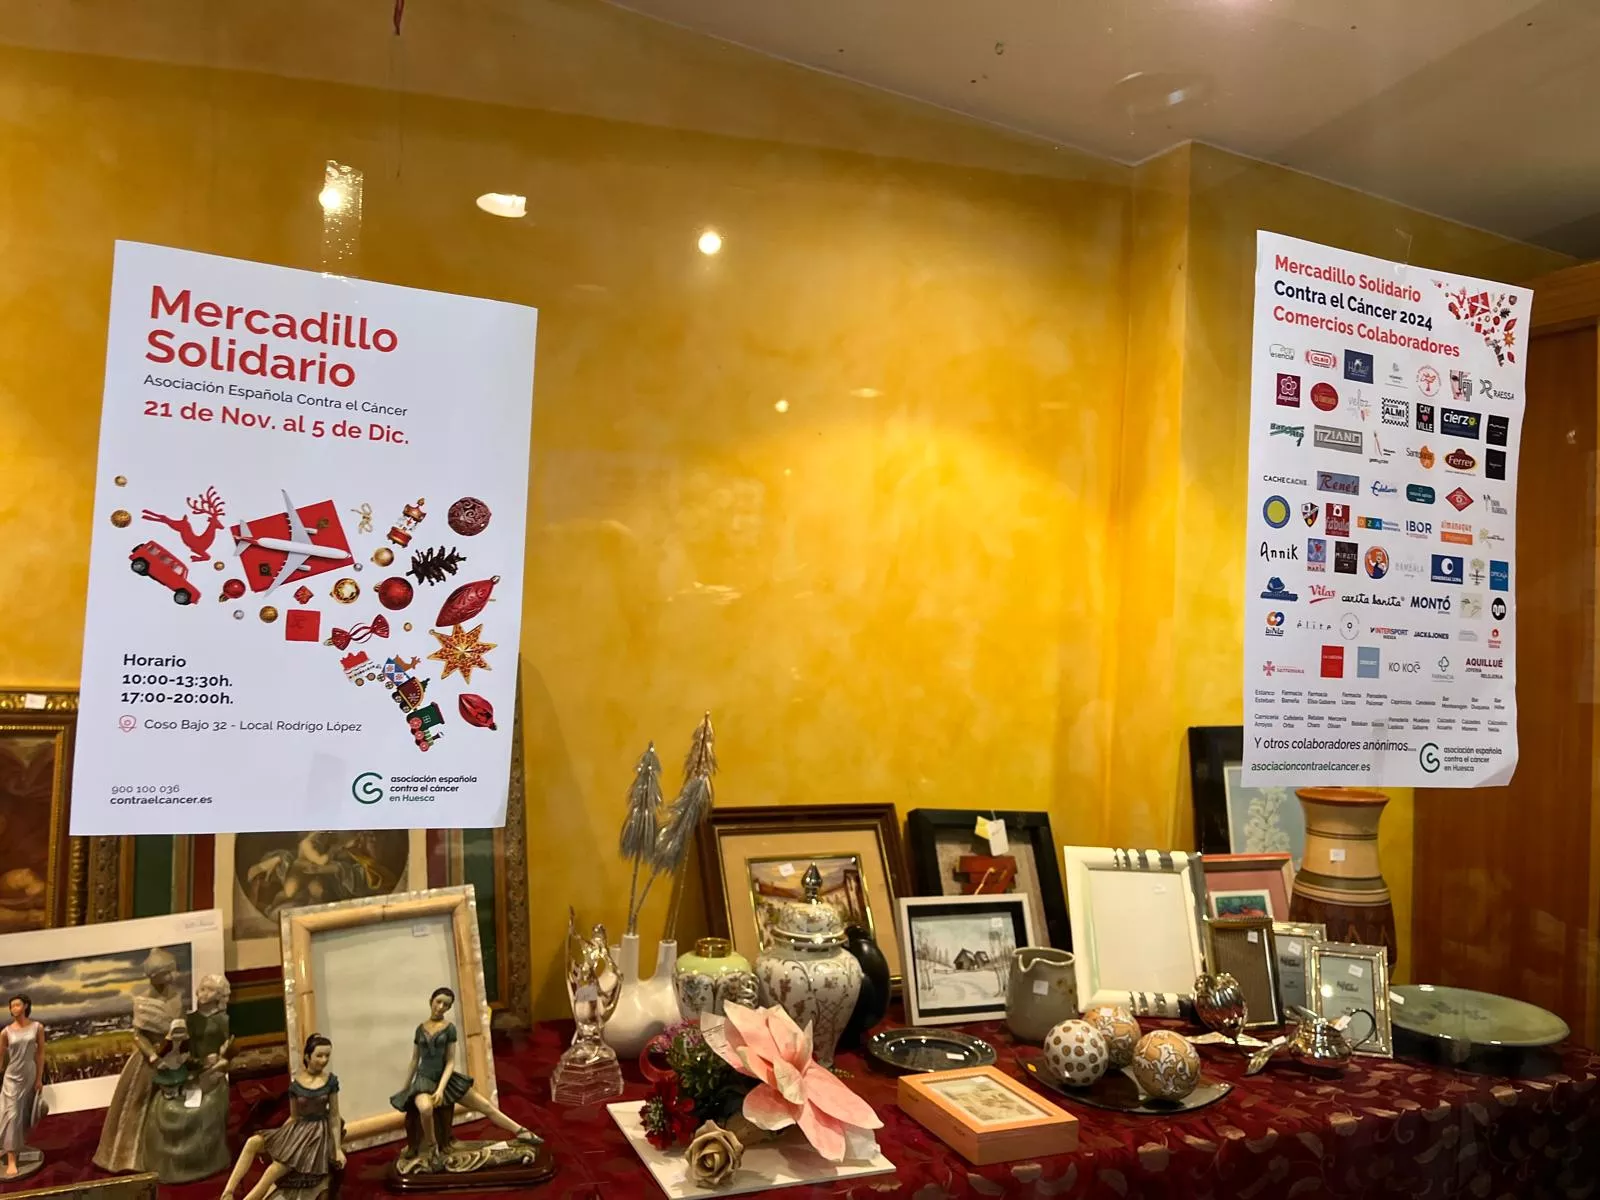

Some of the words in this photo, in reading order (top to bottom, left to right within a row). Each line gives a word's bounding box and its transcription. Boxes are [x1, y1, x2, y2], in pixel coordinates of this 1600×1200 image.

[1275, 254, 1355, 287] Mercadillo
[1359, 274, 1421, 302] Solidario
[1274, 280, 1326, 305] Contra
[1330, 293, 1344, 309] el
[1347, 296, 1397, 321] Cáncer
[1400, 311, 1433, 331] 2024
[150, 285, 398, 353] Mercadillo
[1273, 305, 1354, 336] Comercios
[1357, 323, 1460, 357] Colaboradores
[145, 329, 356, 388] Solidario
[143, 374, 225, 394] Asociación
[228, 384, 293, 403] Española
[296, 393, 342, 409] Contra
[345, 400, 358, 411] el
[361, 401, 408, 417] Cáncer
[1385, 407, 1405, 418] ALMI
[144, 400, 172, 417] 21
[180, 402, 213, 421] de
[221, 405, 275, 430] Nov.
[283, 415, 305, 433] al
[312, 420, 325, 438] 5
[332, 420, 361, 438] de
[368, 423, 409, 444] Dic.
[1448, 454, 1475, 467] Ferrer
[1263, 474, 1285, 483] CACHE
[1405, 520, 1432, 534] IBOR
[1308, 584, 1336, 598] Vilas
[1341, 593, 1369, 604] carita
[1410, 595, 1451, 610] MONTÓ
[1375, 626, 1408, 635] INTERSPORT
[123, 653, 187, 668] Horario
[1465, 657, 1503, 668] AQUILLUÉ
[122, 674, 233, 688] 10:00-13:30h.
[121, 692, 234, 705] 17:00-20:00h.
[143, 719, 178, 730] Coso
[181, 719, 209, 732] Bajo
[213, 721, 227, 732] 32
[240, 720, 273, 730] Local
[326, 721, 362, 733] López
[1254, 737, 1262, 749] Y
[1263, 738, 1290, 750] otros
[1291, 738, 1361, 751] colaboradores
[1443, 746, 1475, 754] asociación
[1475, 747, 1503, 756] española
[1443, 755, 1464, 763] contra
[1464, 755, 1470, 763] el
[1251, 760, 1371, 772] asociacioncontraelcancer.es
[1444, 764, 1452, 772] en
[1453, 764, 1475, 772] Huesca
[390, 774, 437, 783] asociación
[438, 774, 478, 785] española
[111, 785, 134, 795] 900
[136, 785, 157, 793] 100
[159, 784, 180, 794] 036
[389, 784, 419, 792] contra
[420, 784, 428, 792] el
[429, 784, 460, 792] cáncer
[110, 795, 213, 804] contraelcancer.es
[402, 794, 435, 802] Huesca
